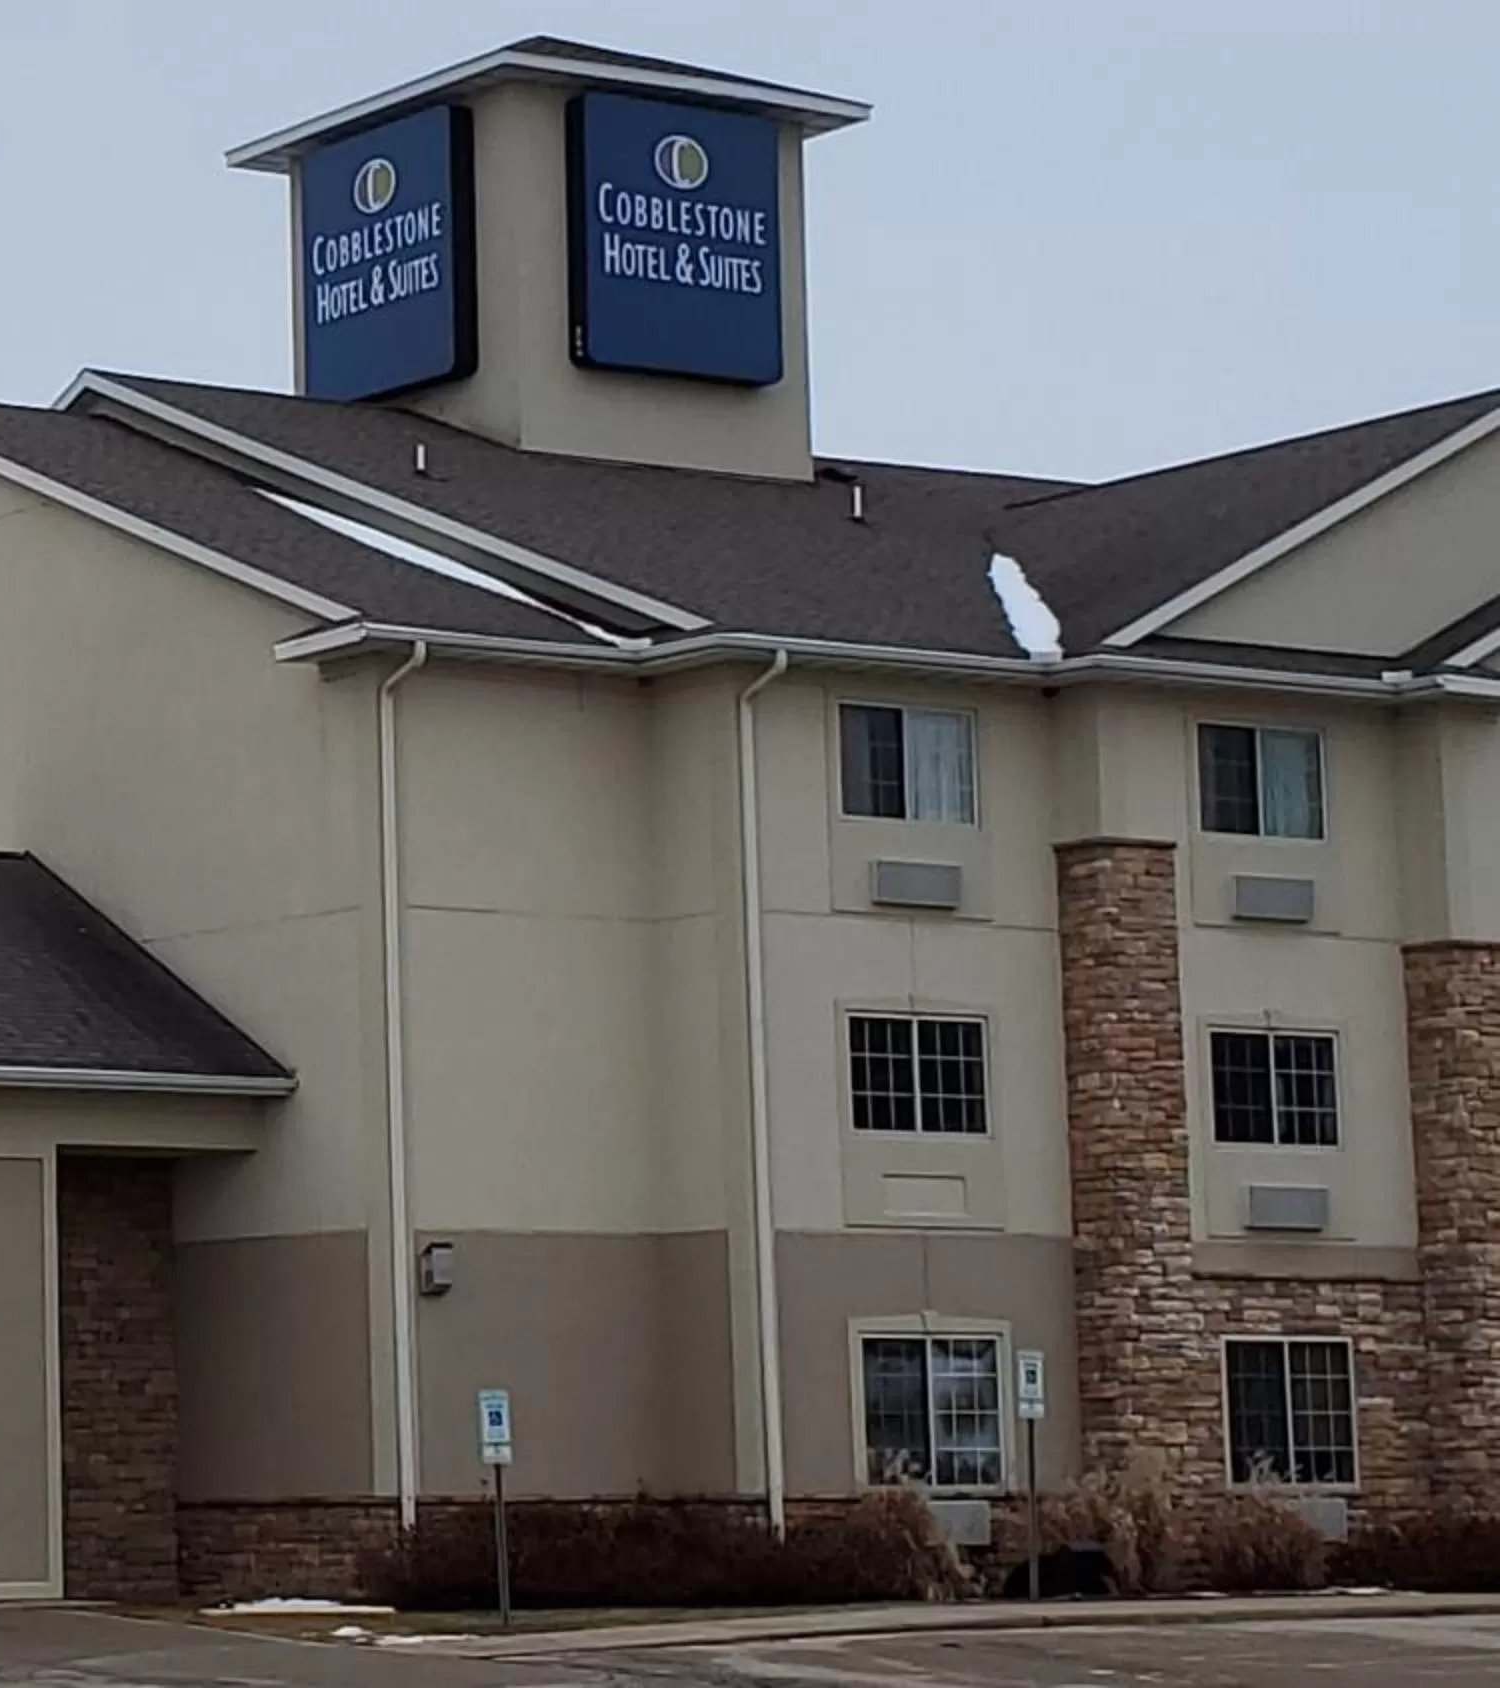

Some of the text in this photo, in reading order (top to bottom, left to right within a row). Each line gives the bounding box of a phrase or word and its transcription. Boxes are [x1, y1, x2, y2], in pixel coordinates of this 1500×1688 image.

[312, 201, 442, 276] COBBLESTONE
[599, 182, 767, 246] COBBLESTONE
[316, 253, 439, 325] HOTEL & SUITES
[603, 232, 762, 294] HOTEL & SUITES
